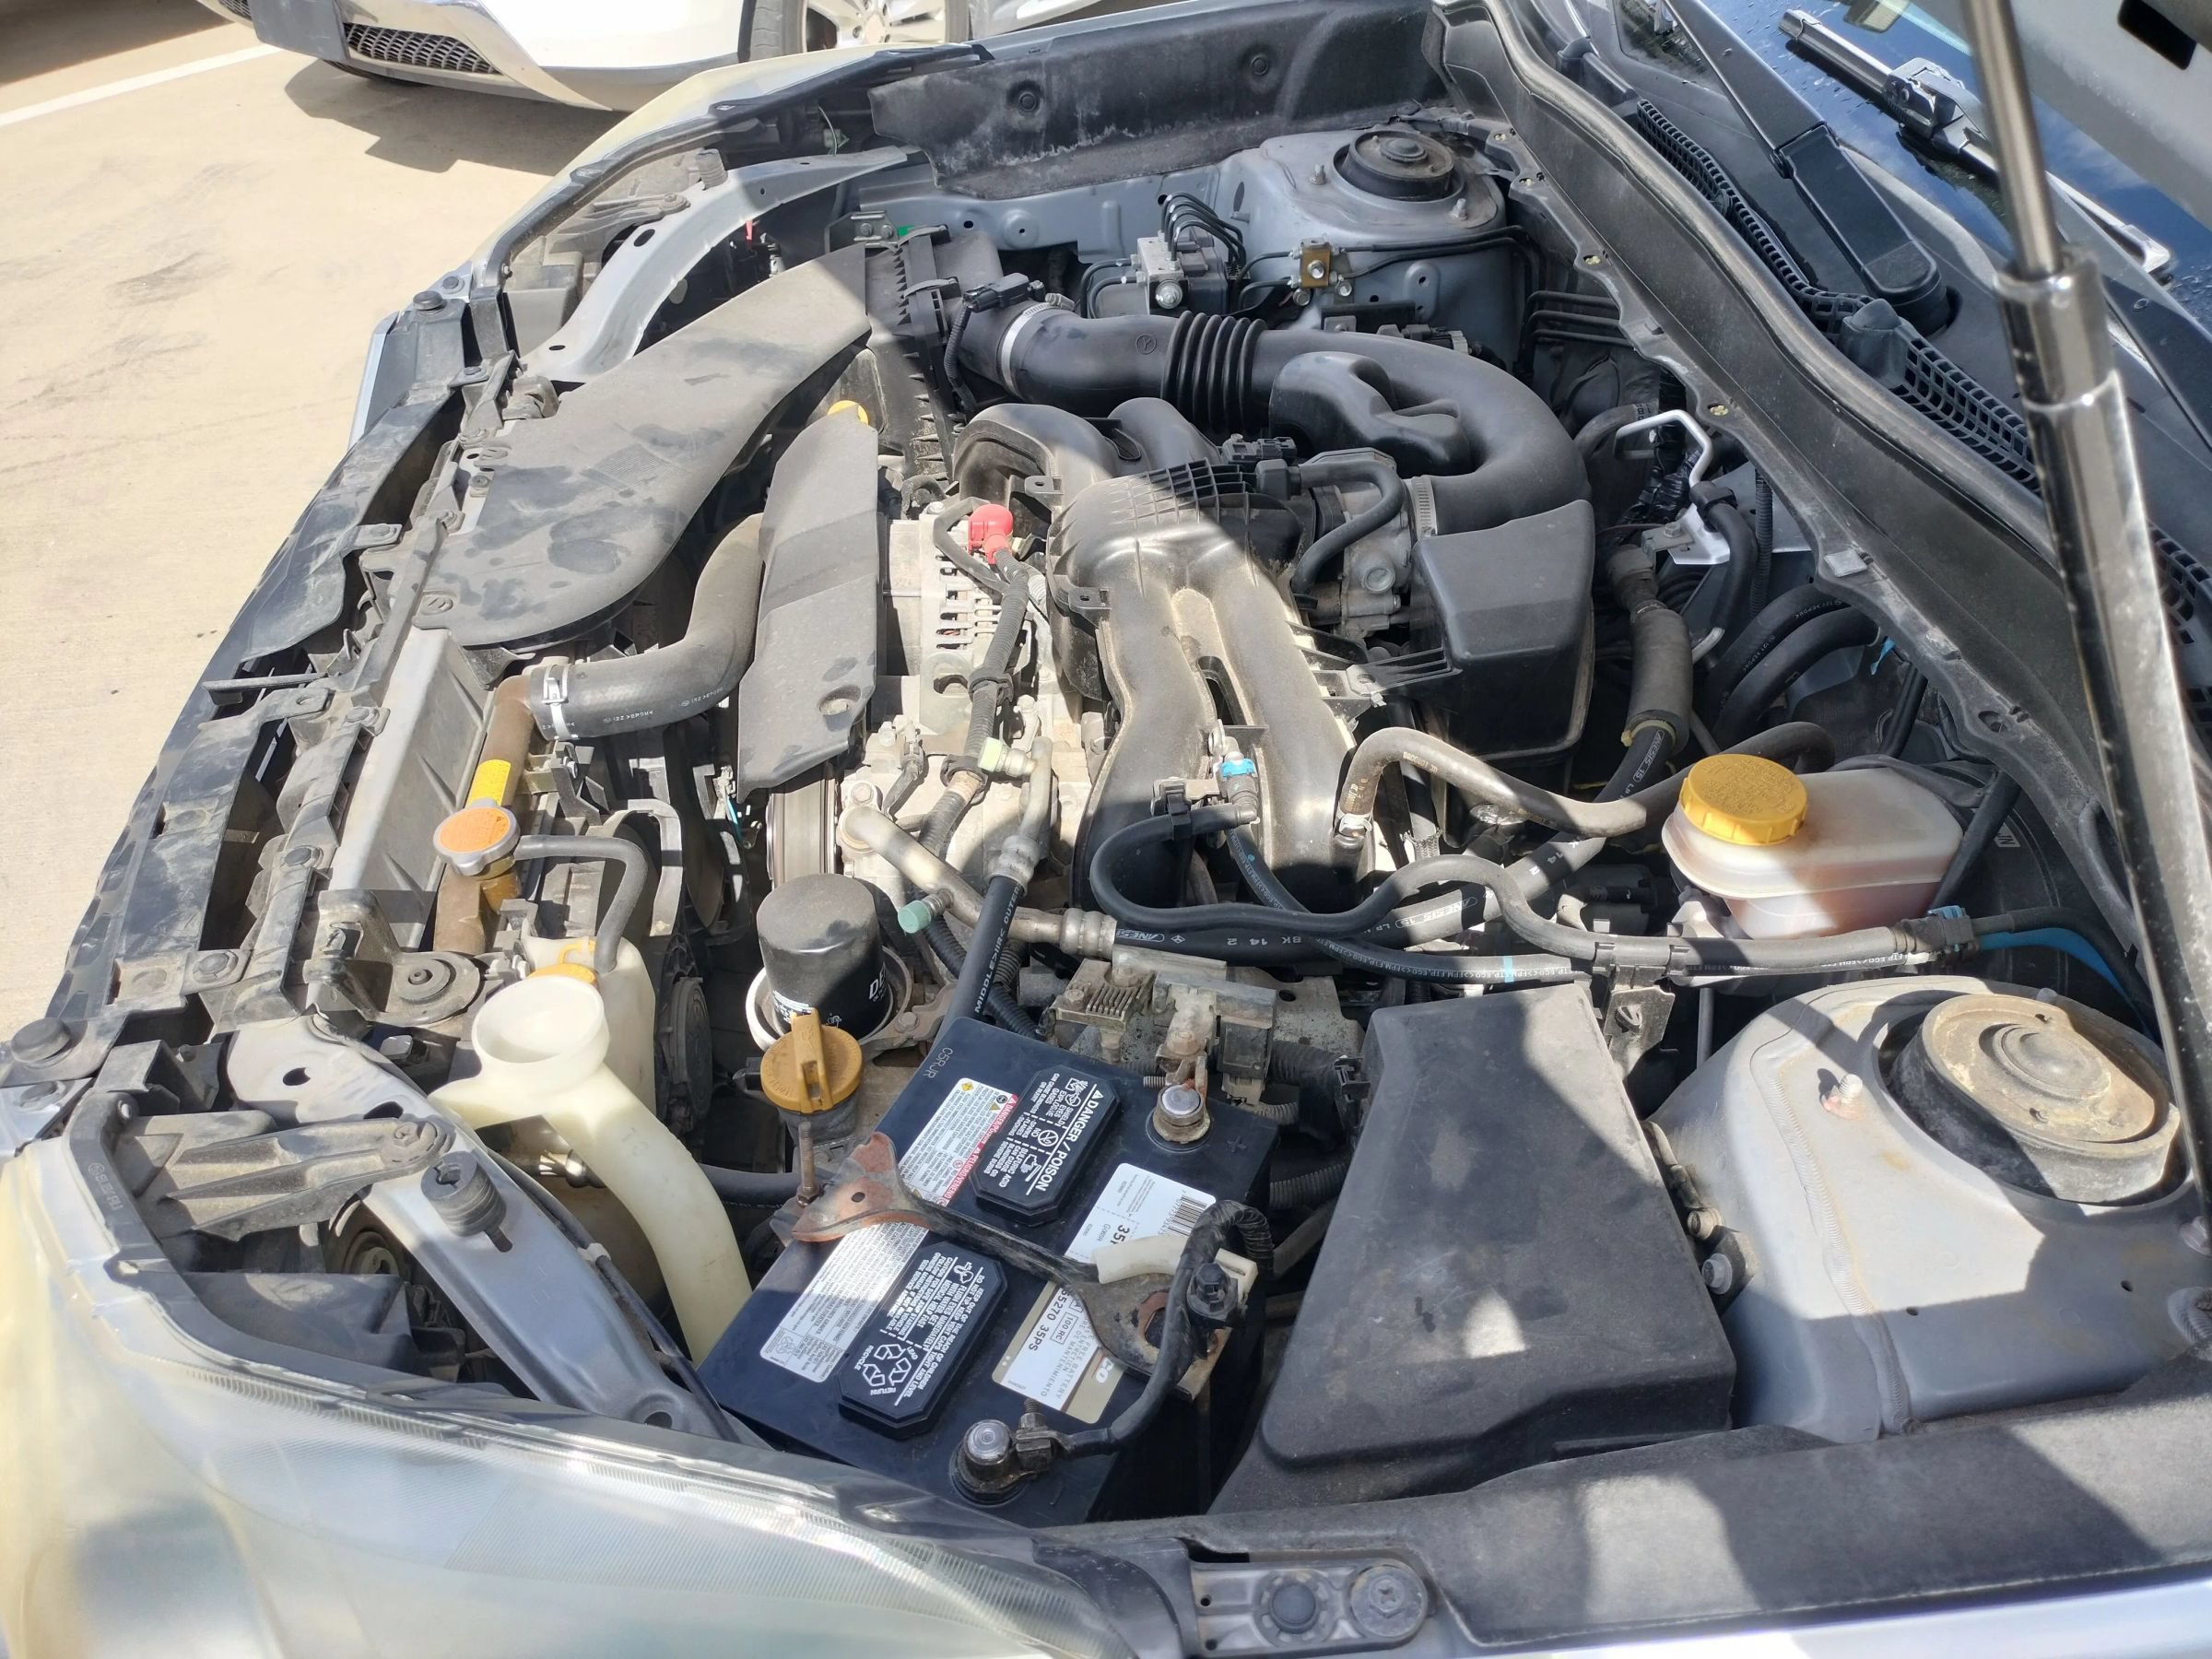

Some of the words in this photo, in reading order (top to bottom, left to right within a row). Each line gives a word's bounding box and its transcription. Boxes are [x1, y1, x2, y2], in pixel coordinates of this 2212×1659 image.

[1043, 1088, 1059, 1104] GASES
[1044, 1089, 1066, 1117] EXPLOSIVE
[1053, 1104, 1066, 1117] EYES
[1057, 1106, 1074, 1125] SHIELD
[1065, 1100, 1099, 1142] DANGER
[1030, 1127, 1041, 1137] NO
[1010, 1145, 1020, 1155] CAN
[999, 1155, 1015, 1171] CAUSE
[1006, 1147, 1029, 1174] SULFURIC
[1034, 1150, 1067, 1191] POISON
[997, 1173, 1012, 1188] ACID
[976, 1275, 984, 1283] DO
[933, 1278, 952, 1301] MEDICAL
[946, 1282, 959, 1296] WITH
[951, 1285, 967, 1301] FLUSH
[968, 1283, 979, 1295] NOT
[971, 1288, 984, 1301] KEEP
[924, 1300, 938, 1314] HELP
[942, 1300, 957, 1315] EYES
[952, 1306, 965, 1321] KEEP
[964, 1301, 975, 1313] OUT
[915, 1314, 929, 1328] FAST
[927, 1313, 938, 1325] GET
[958, 1313, 968, 1323] OF
[1061, 1316, 1073, 1330] 100
[922, 1314, 948, 1348] IMMEDIATELY
[943, 1321, 956, 1335] VENT
[951, 1323, 962, 1334] THE
[1054, 1329, 1065, 1340] RC
[934, 1335, 947, 1350] CAPS
[939, 1334, 955, 1352] REACH
[1027, 1324, 1050, 1352] 35PS
[853, 1344, 874, 1371] RECYCLE
[923, 1350, 937, 1367] TIGHT
[934, 1352, 944, 1361] OF
[1075, 1342, 1090, 1361] FREE
[914, 1367, 926, 1380] AND
[916, 1361, 938, 1389] CHILDREN
[1053, 1361, 1079, 1399] BATTERY
